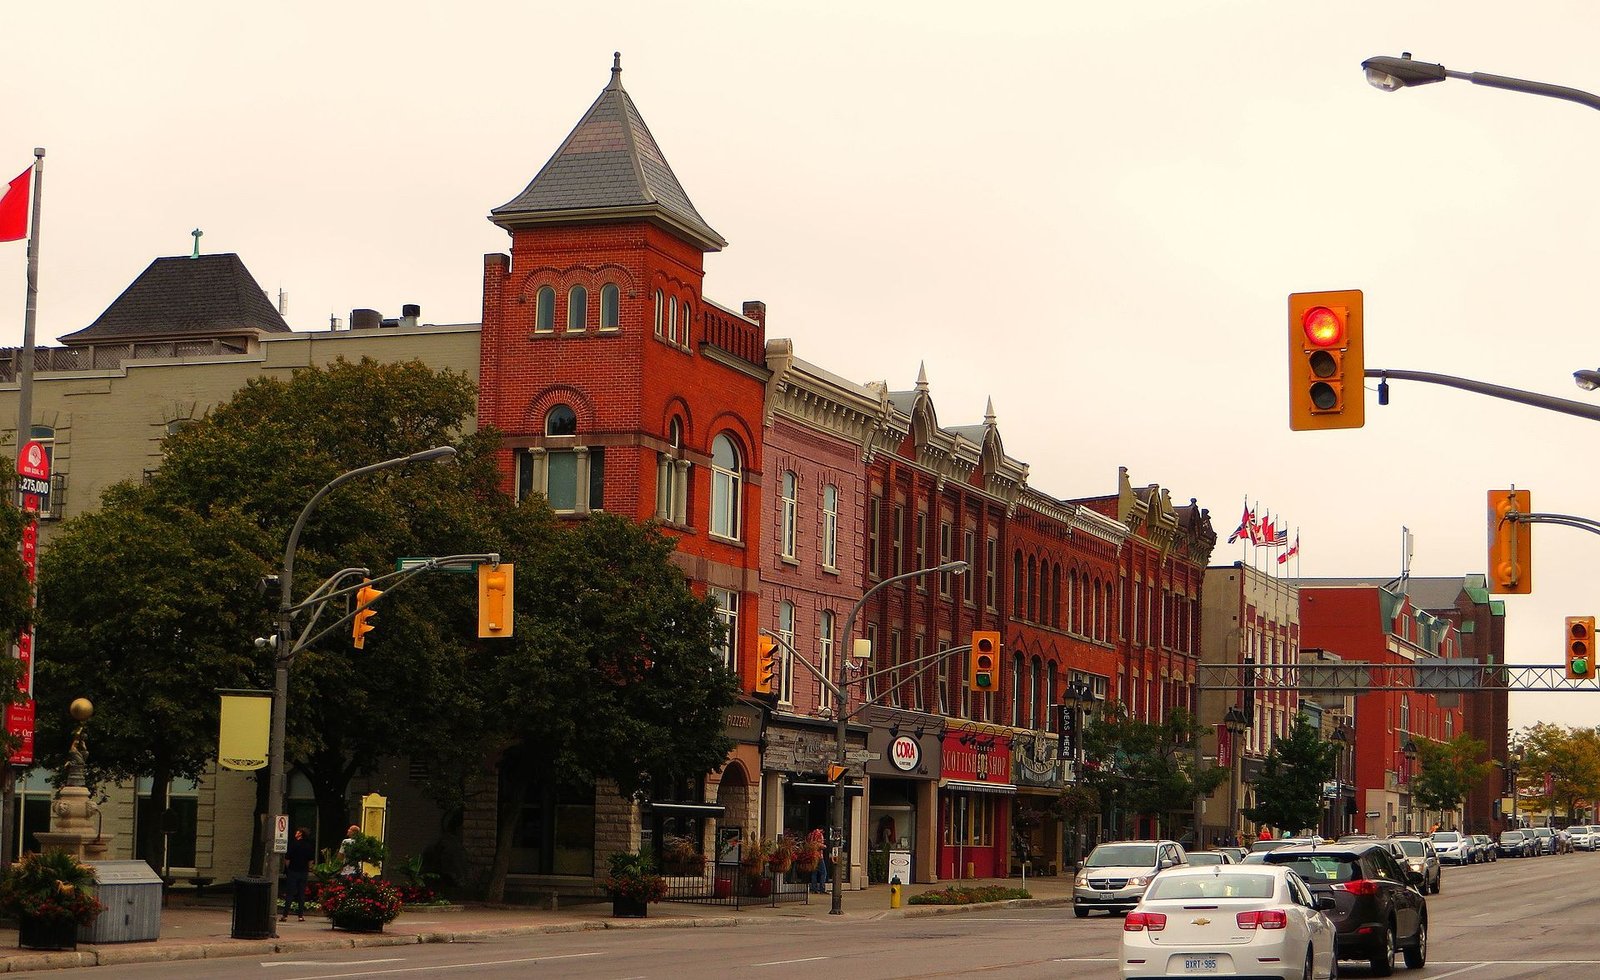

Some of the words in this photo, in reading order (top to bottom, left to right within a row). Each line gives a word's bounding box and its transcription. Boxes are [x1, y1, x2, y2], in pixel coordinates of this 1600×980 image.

[896, 740, 916, 759] CORA
[1062, 735, 1070, 757] HERE
[942, 749, 977, 773] SCOTTISH
[988, 755, 1006, 776] SHOP
